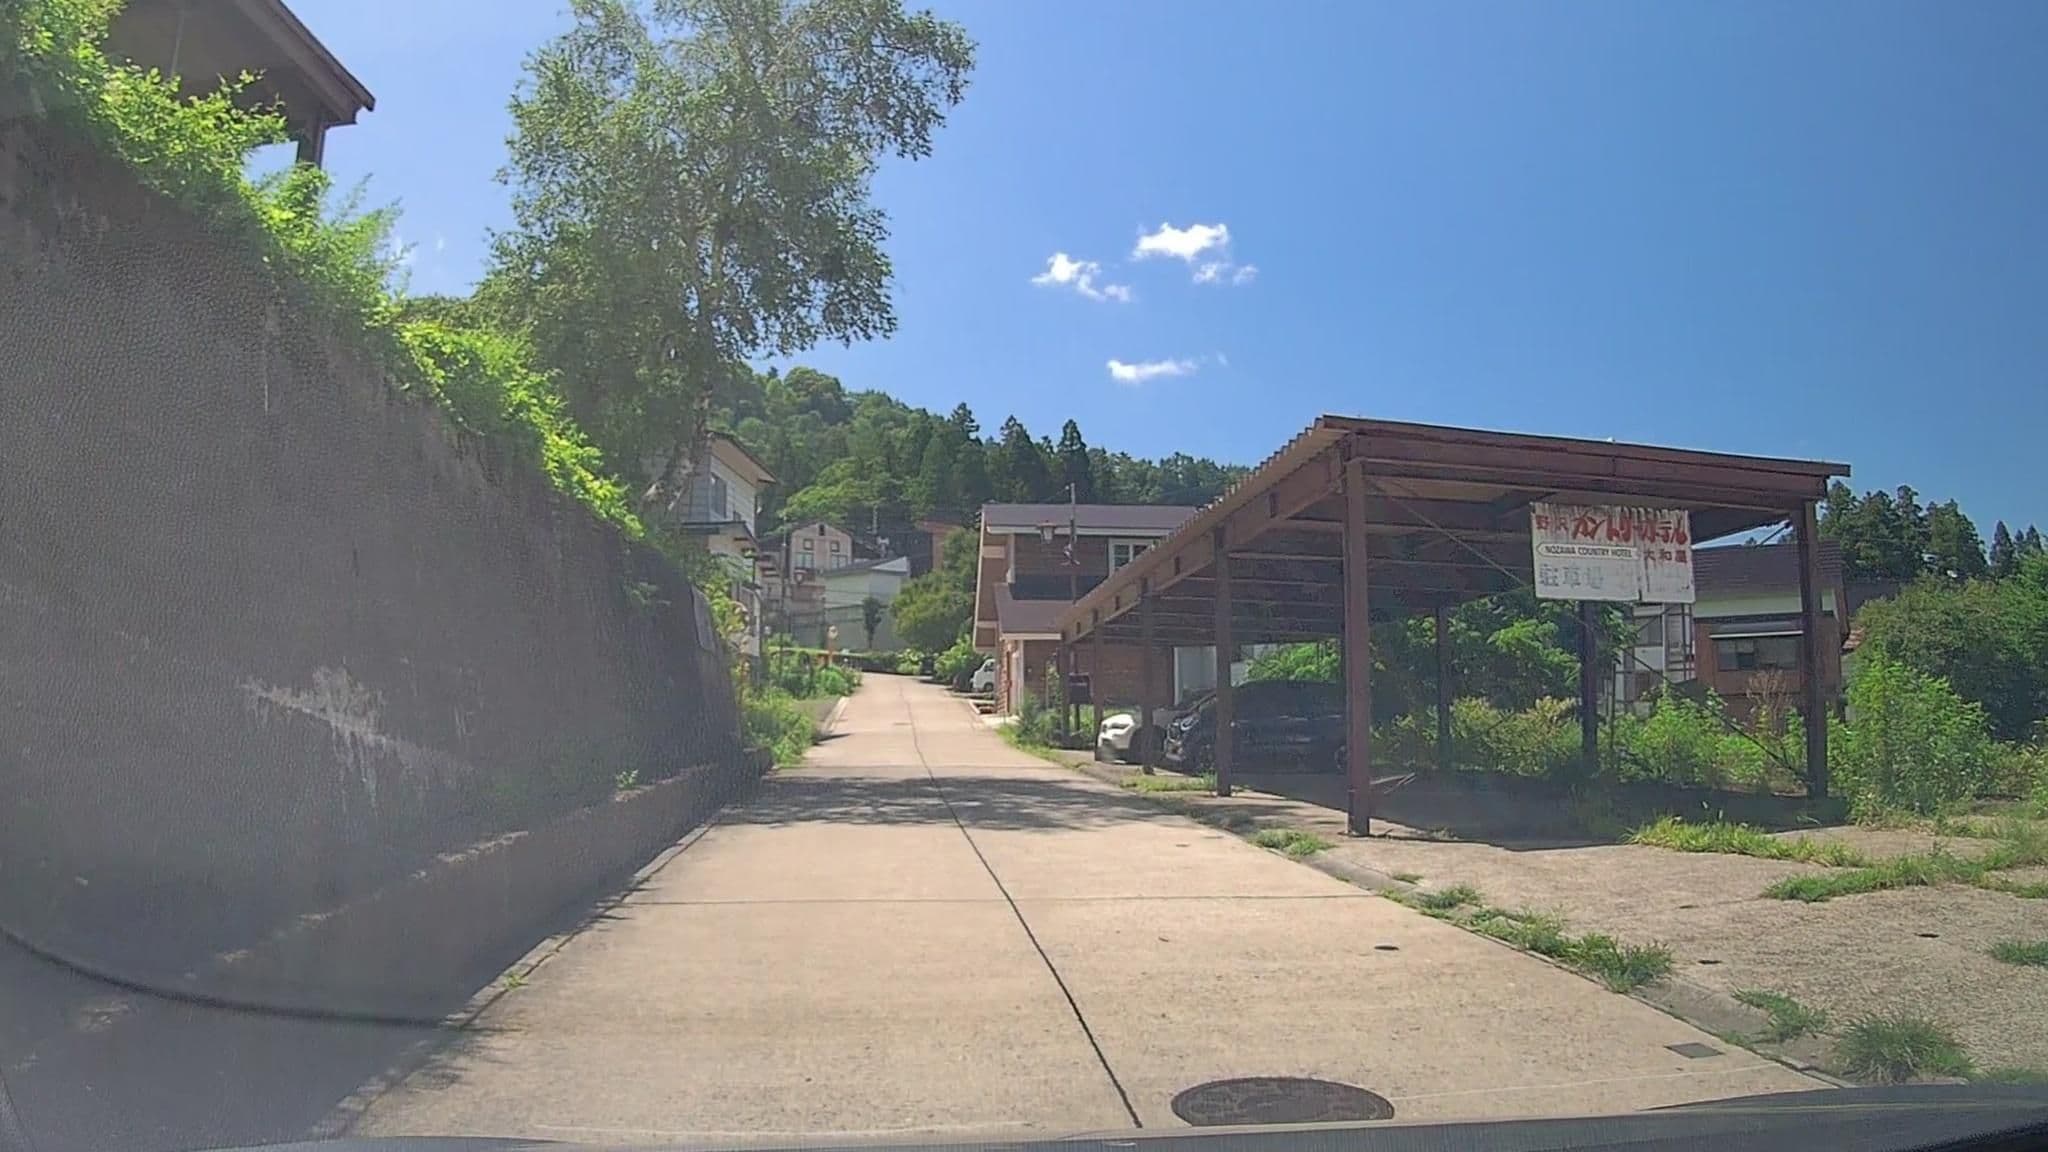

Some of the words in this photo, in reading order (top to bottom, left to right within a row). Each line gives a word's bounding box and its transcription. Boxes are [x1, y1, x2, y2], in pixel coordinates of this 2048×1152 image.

[1545, 545, 1576, 555] NOZAWA
[1578, 547, 1609, 557] COUNTRY
[1611, 548, 1632, 558] HOTEL
